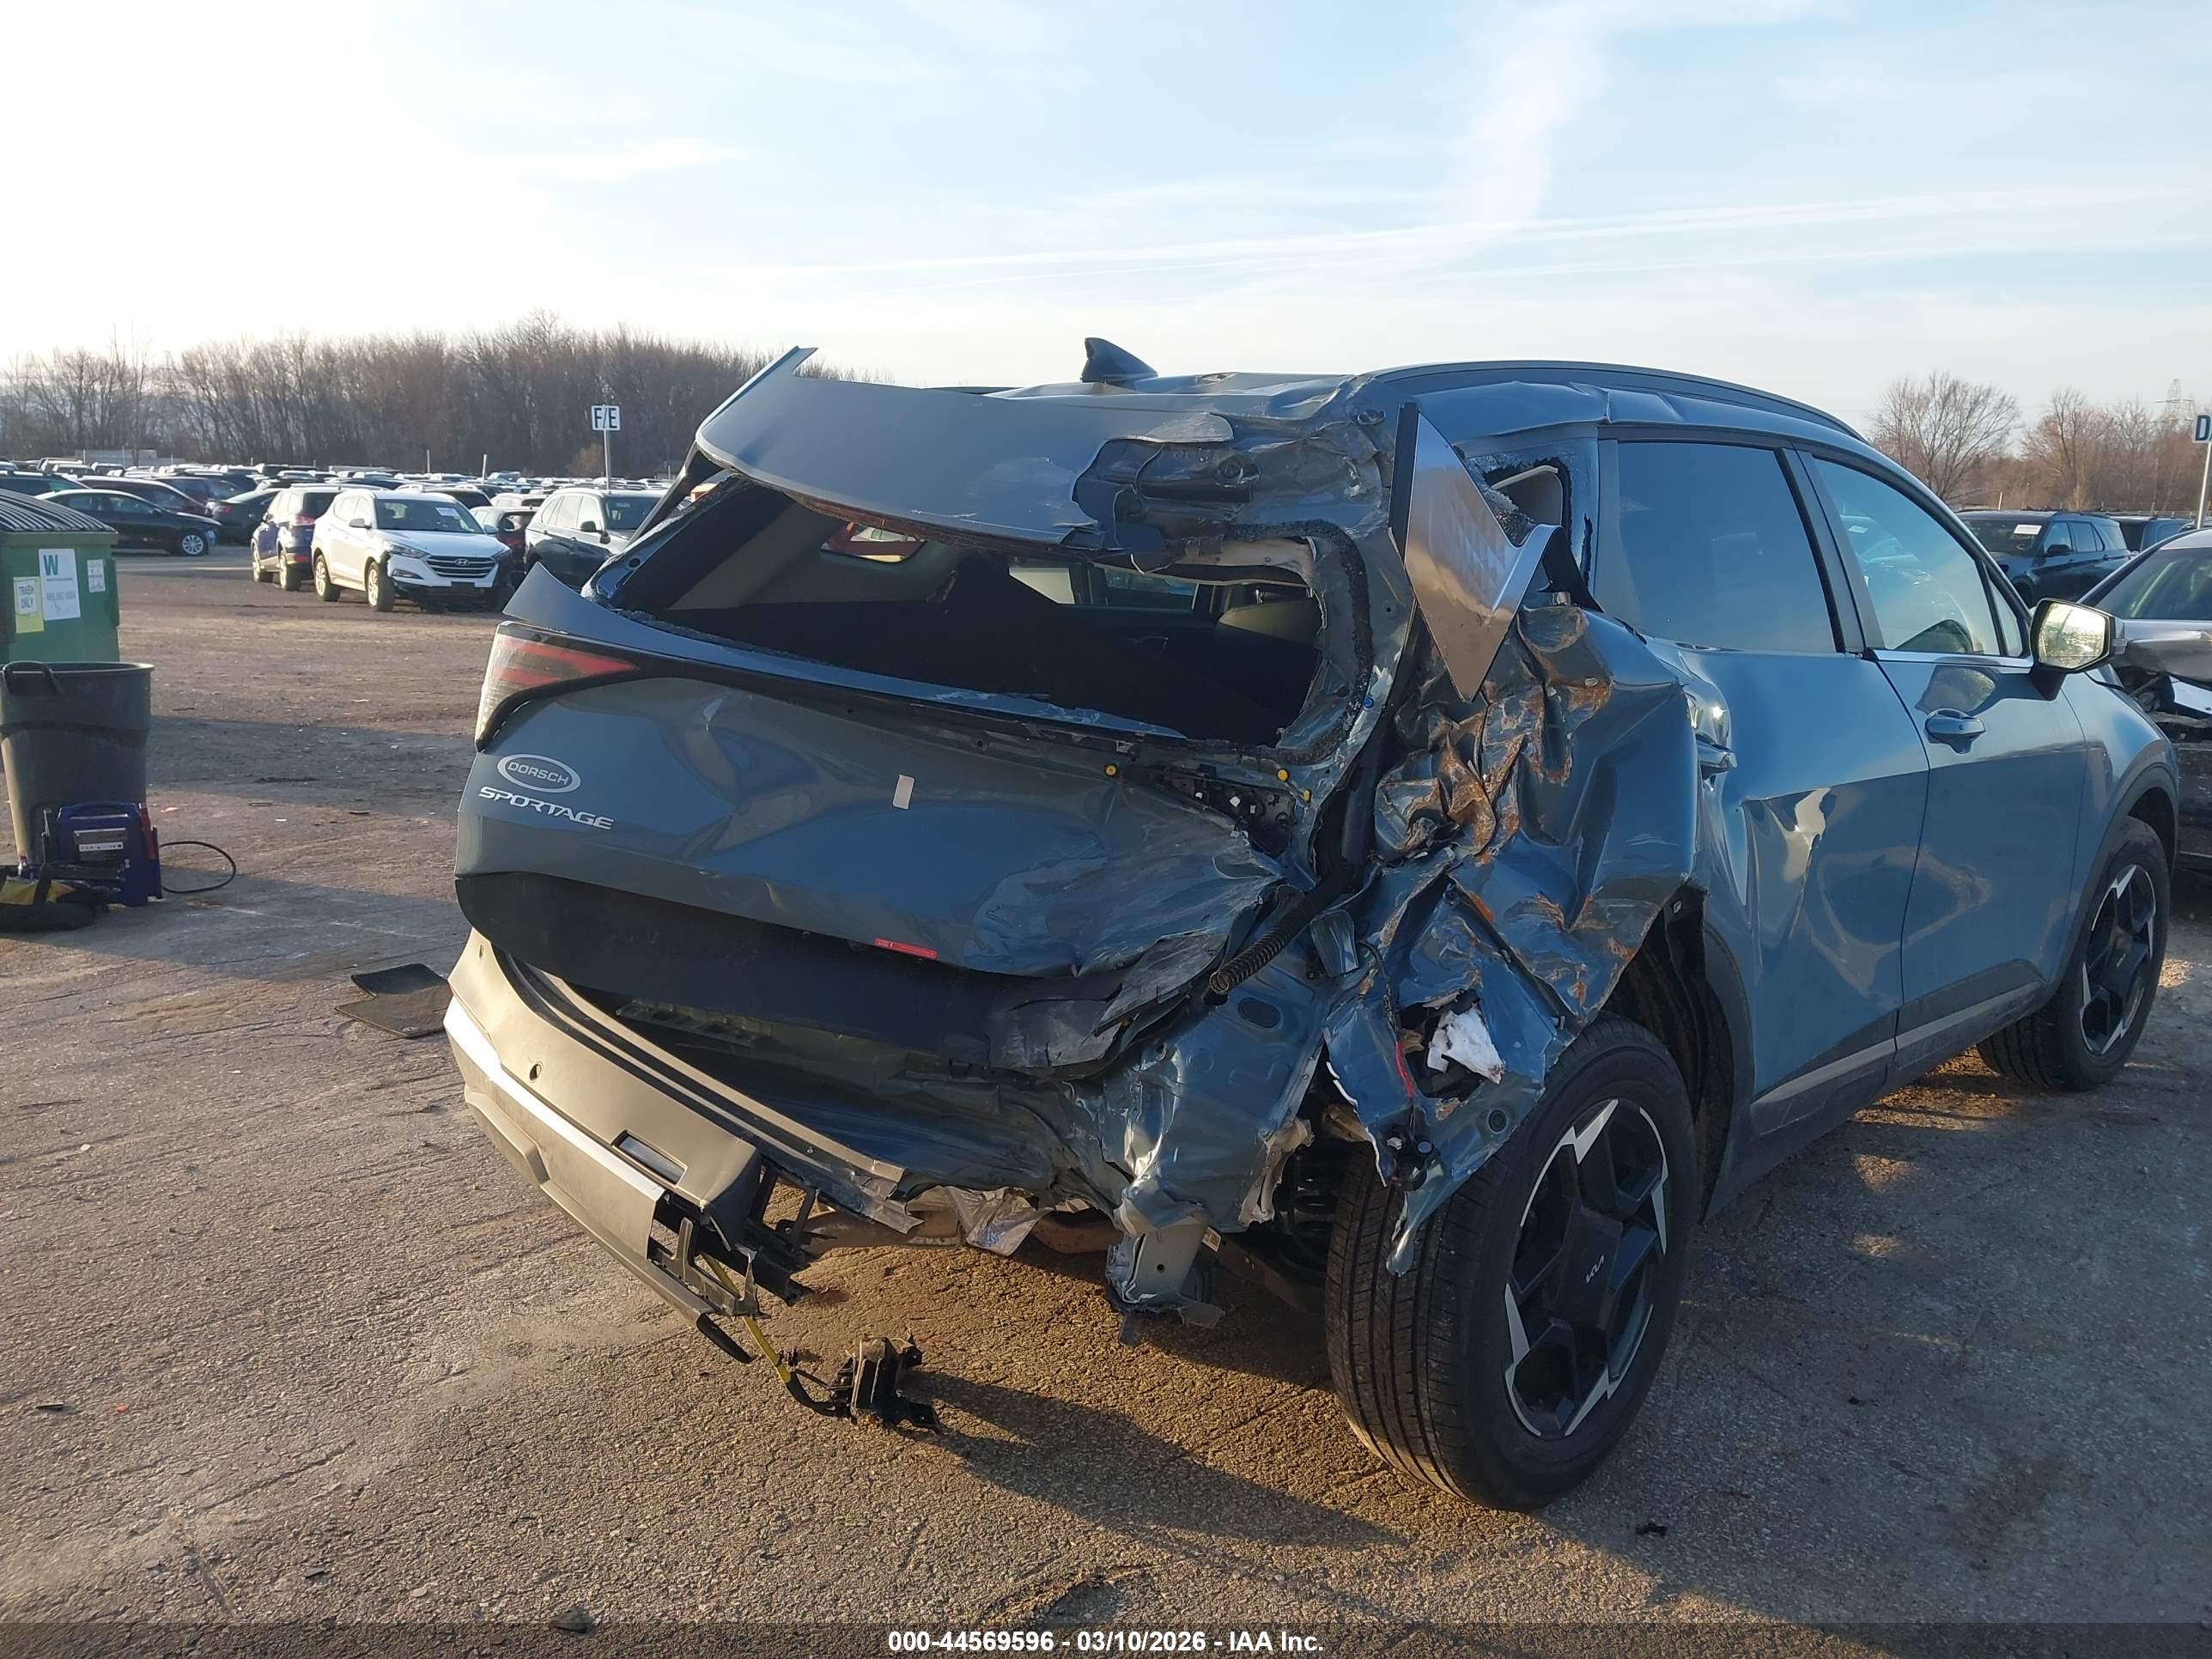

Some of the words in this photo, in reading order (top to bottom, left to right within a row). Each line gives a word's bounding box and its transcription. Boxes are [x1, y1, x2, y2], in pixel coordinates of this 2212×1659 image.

[594, 408, 617, 428] F/E
[507, 762, 569, 785] DORSCH
[478, 787, 614, 830] SPORTAGE
